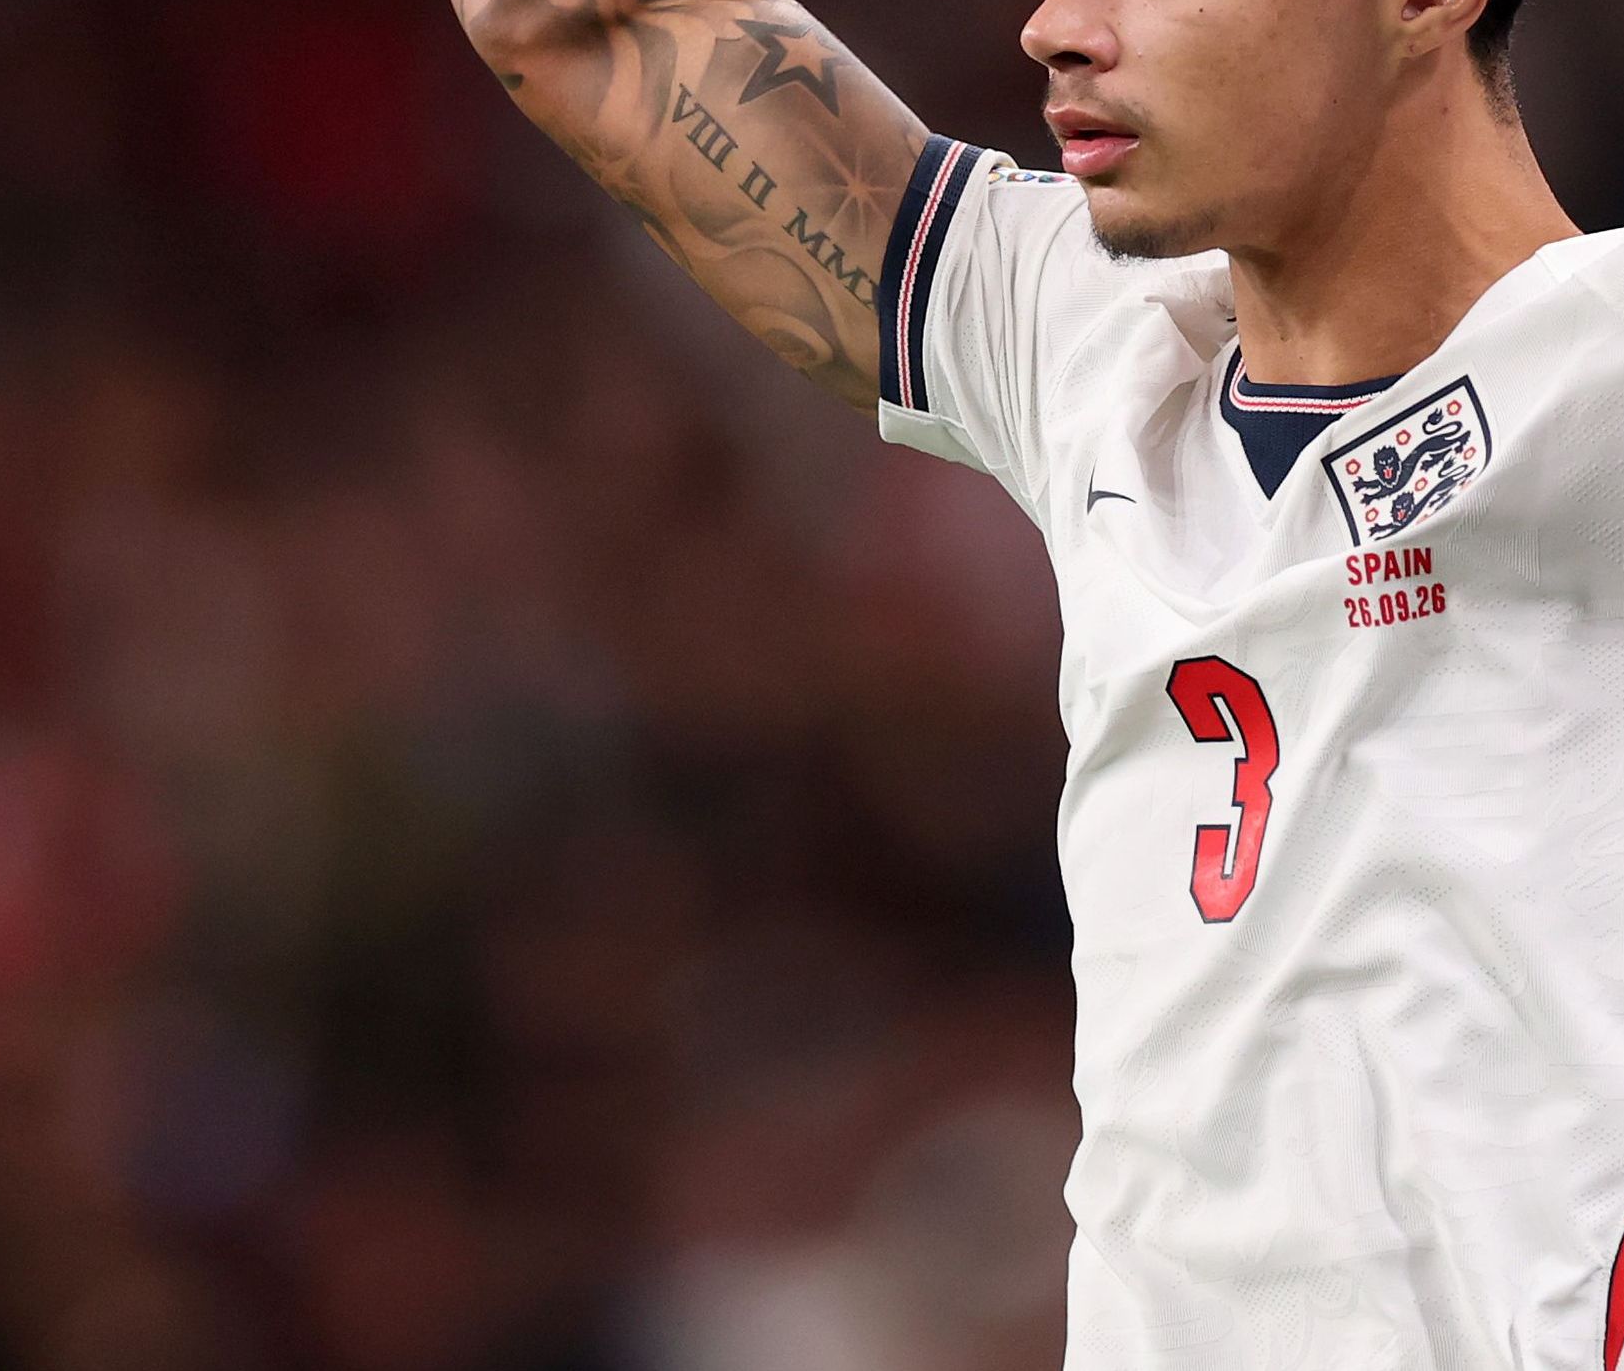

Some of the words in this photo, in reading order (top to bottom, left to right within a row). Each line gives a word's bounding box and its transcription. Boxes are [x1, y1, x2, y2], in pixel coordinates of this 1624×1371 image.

[671, 83, 739, 173] VIII
[738, 160, 778, 211] II
[1344, 583, 1446, 628] 26.09.26
[1346, 547, 1432, 586] SPAIN
[1166, 655, 1280, 924] 3
